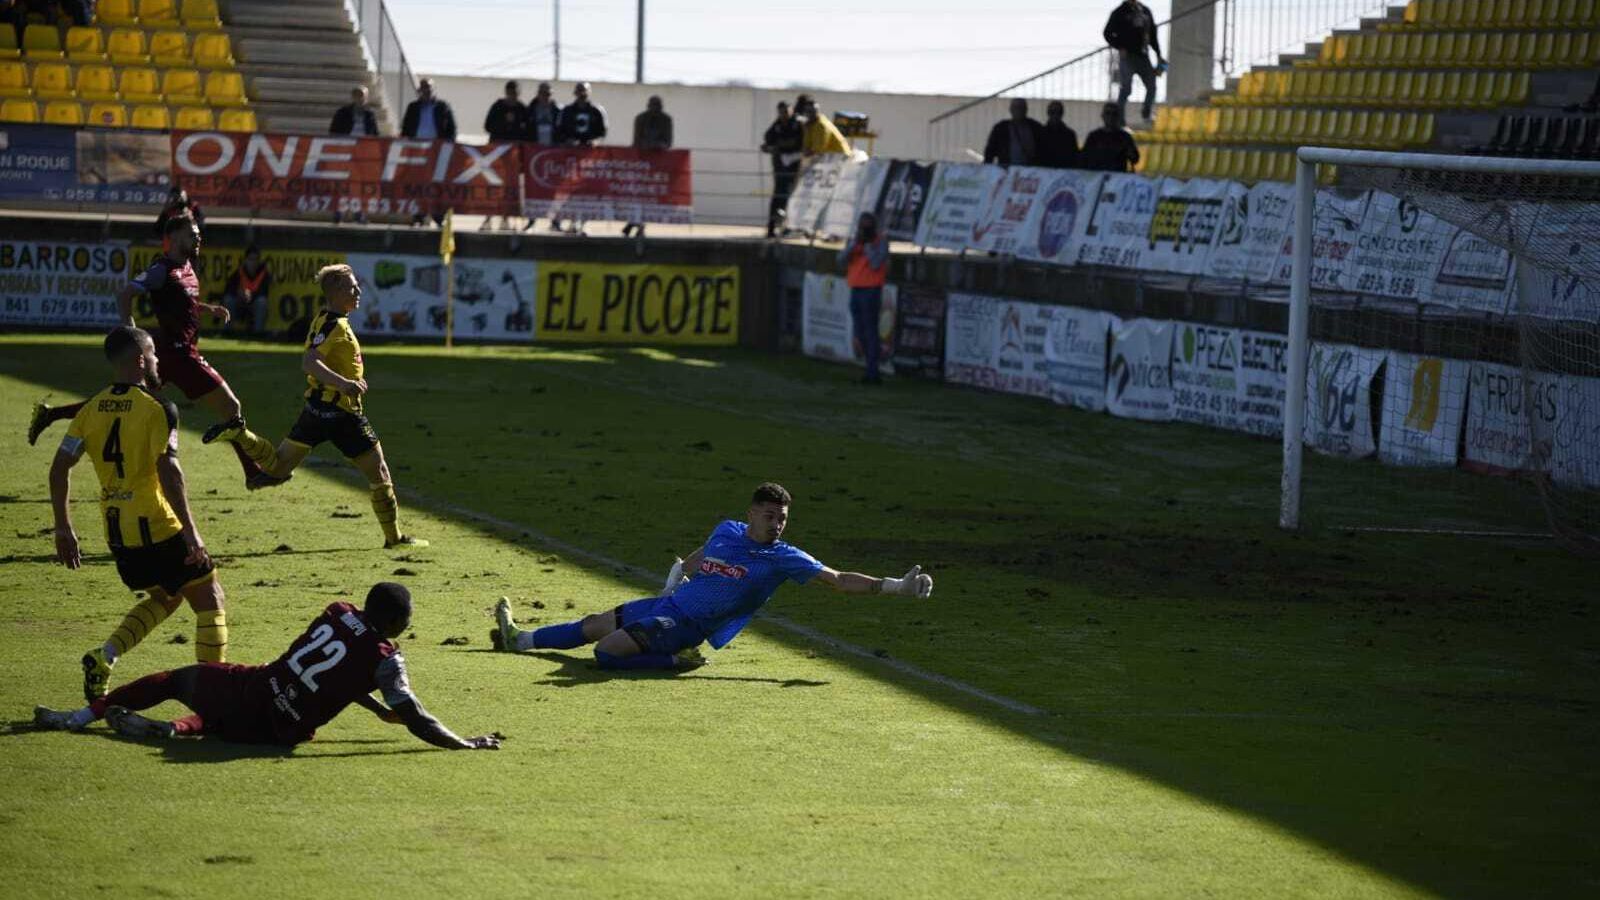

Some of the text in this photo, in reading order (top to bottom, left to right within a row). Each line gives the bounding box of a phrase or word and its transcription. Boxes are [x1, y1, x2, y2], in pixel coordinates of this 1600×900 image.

[16, 155, 71, 171] ROQUE
[174, 131, 358, 181] ONE
[380, 138, 515, 187] FIX
[296, 194, 333, 212] 657
[0, 243, 126, 274] BARROSO
[45, 274, 55, 293] Y
[5, 297, 30, 314] 841
[41, 298, 67, 315] 679
[98, 301, 119, 316] 84
[544, 271, 588, 332] EL
[600, 273, 736, 336] PICOTE
[103, 416, 126, 480] 4
[286, 623, 348, 692] 22
